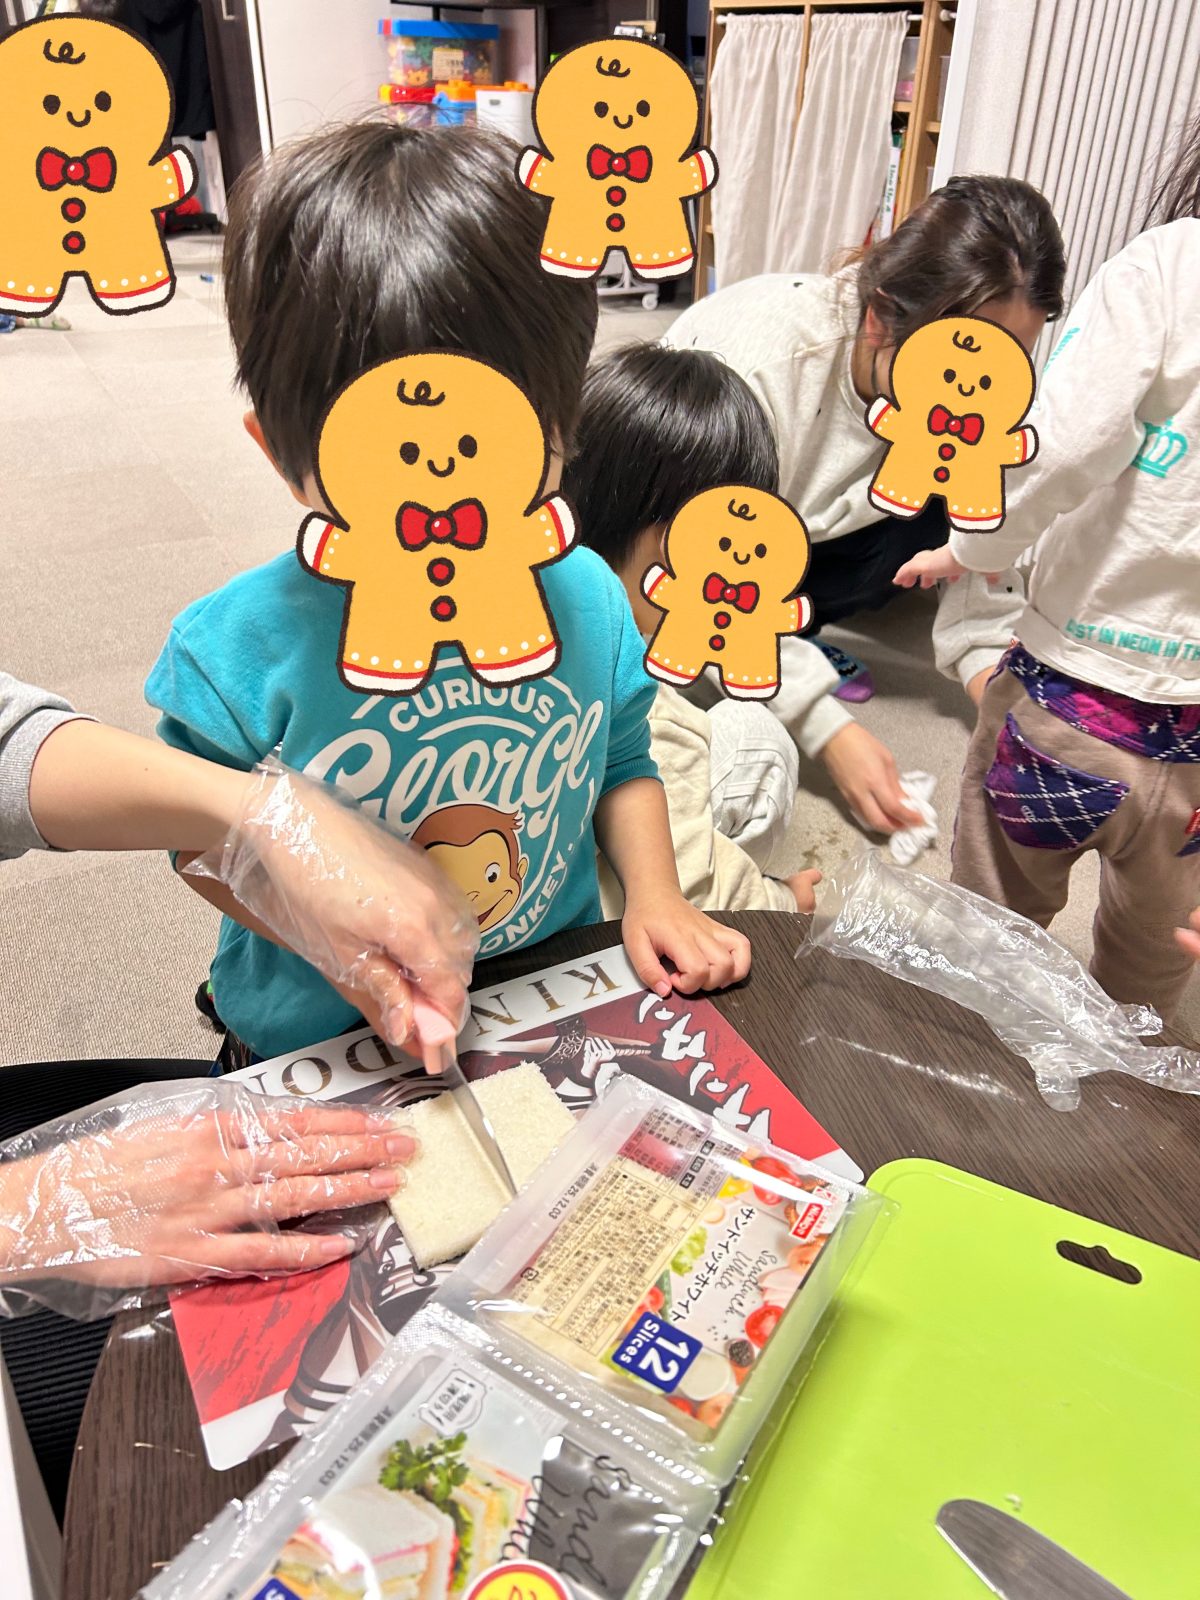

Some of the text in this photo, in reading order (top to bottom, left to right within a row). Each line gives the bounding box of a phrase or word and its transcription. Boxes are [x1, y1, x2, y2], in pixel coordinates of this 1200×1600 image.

[1117, 630, 1162, 656] NEON
[389, 678, 556, 732] CURIOUS
[480, 850, 567, 954] ONKEY
[672, 1207, 755, 1321] サンドイッチホワイト
[715, 1251, 753, 1290] White
[725, 1250, 778, 1319] Sandwich
[620, 1319, 660, 1364] Slices
[638, 1336, 691, 1382] 12
